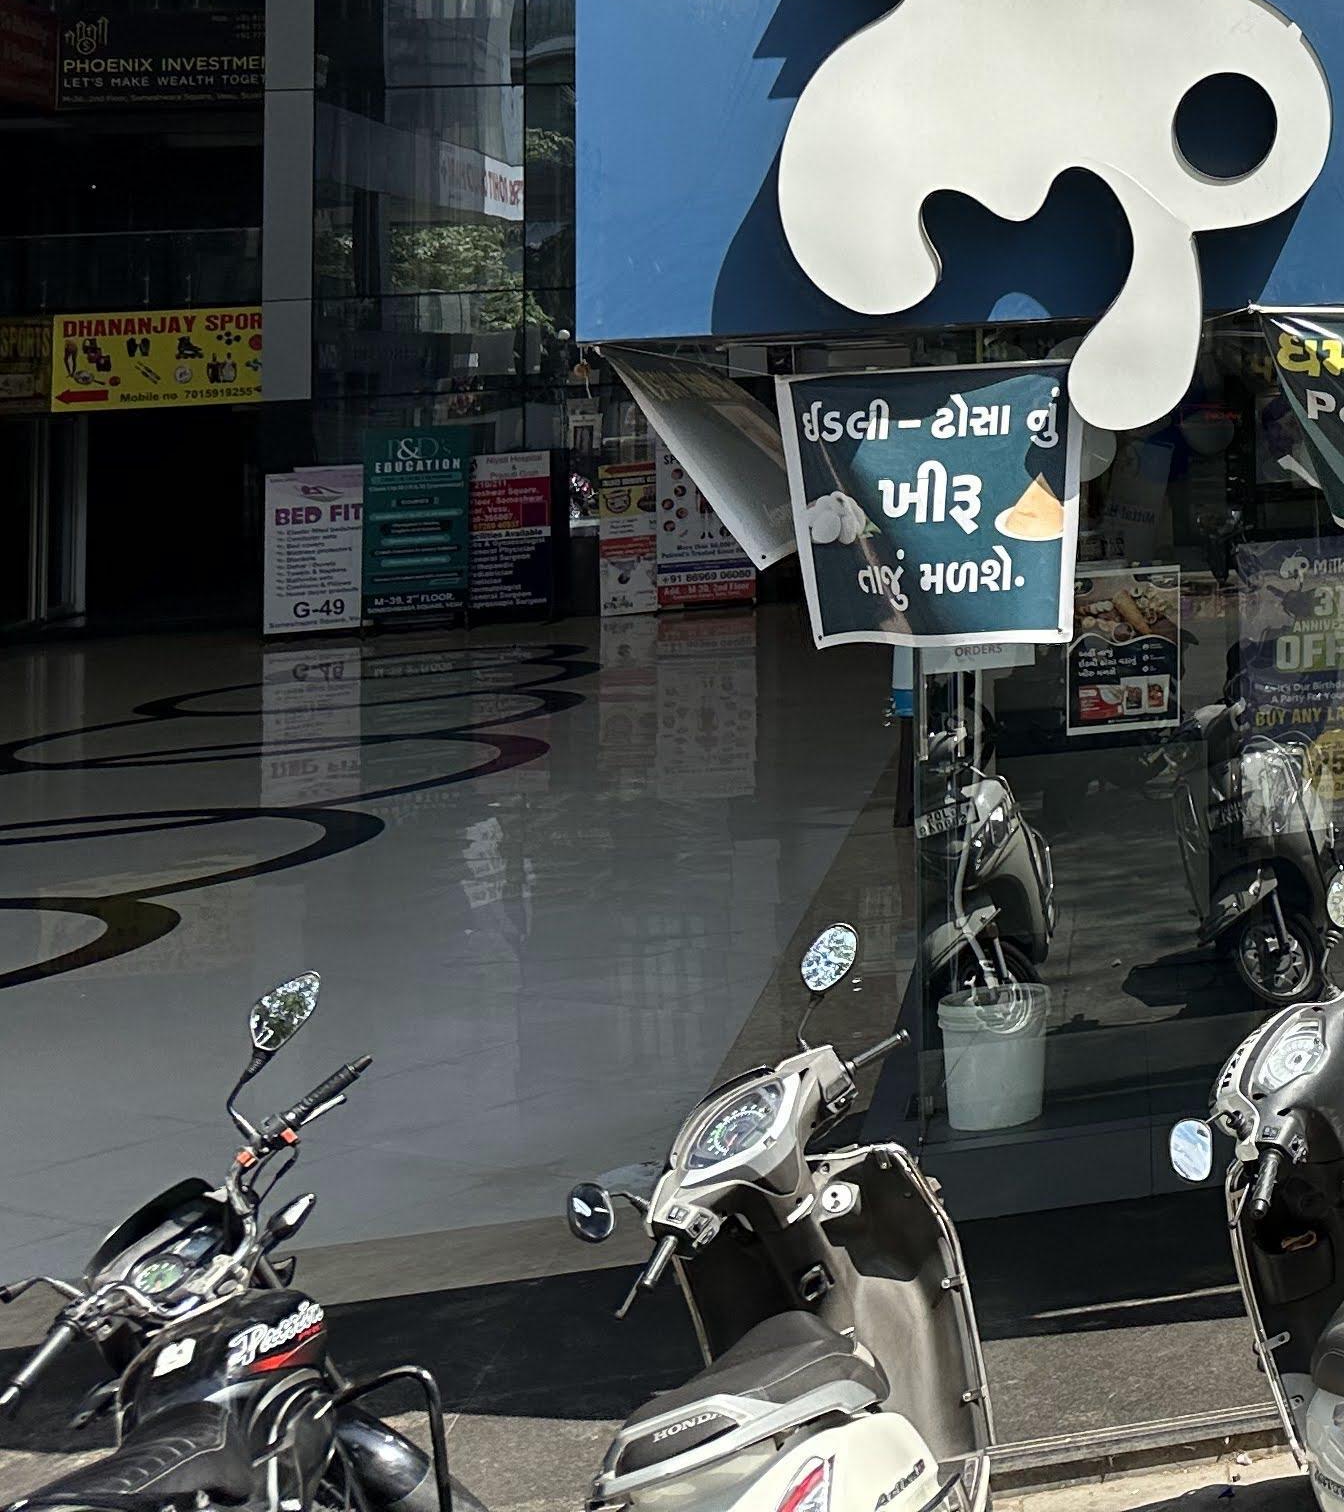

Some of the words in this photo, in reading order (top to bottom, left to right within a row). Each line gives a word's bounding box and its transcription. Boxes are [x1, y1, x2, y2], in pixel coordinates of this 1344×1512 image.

[63, 57, 153, 73] PHOENIX
[63, 76, 104, 88] LET'S
[111, 75, 151, 87] MAKE
[157, 74, 215, 87] WEALTH
[63, 315, 197, 338] DHANANJAY
[120, 392, 159, 403] Mobile
[162, 393, 178, 401] no
[374, 457, 461, 474] EDUCATION
[274, 505, 322, 526] BED
[330, 502, 363, 523] FIT
[292, 598, 345, 619] G-49
[1255, 709, 1287, 728] BUY
[1291, 707, 1324, 725] ANY
